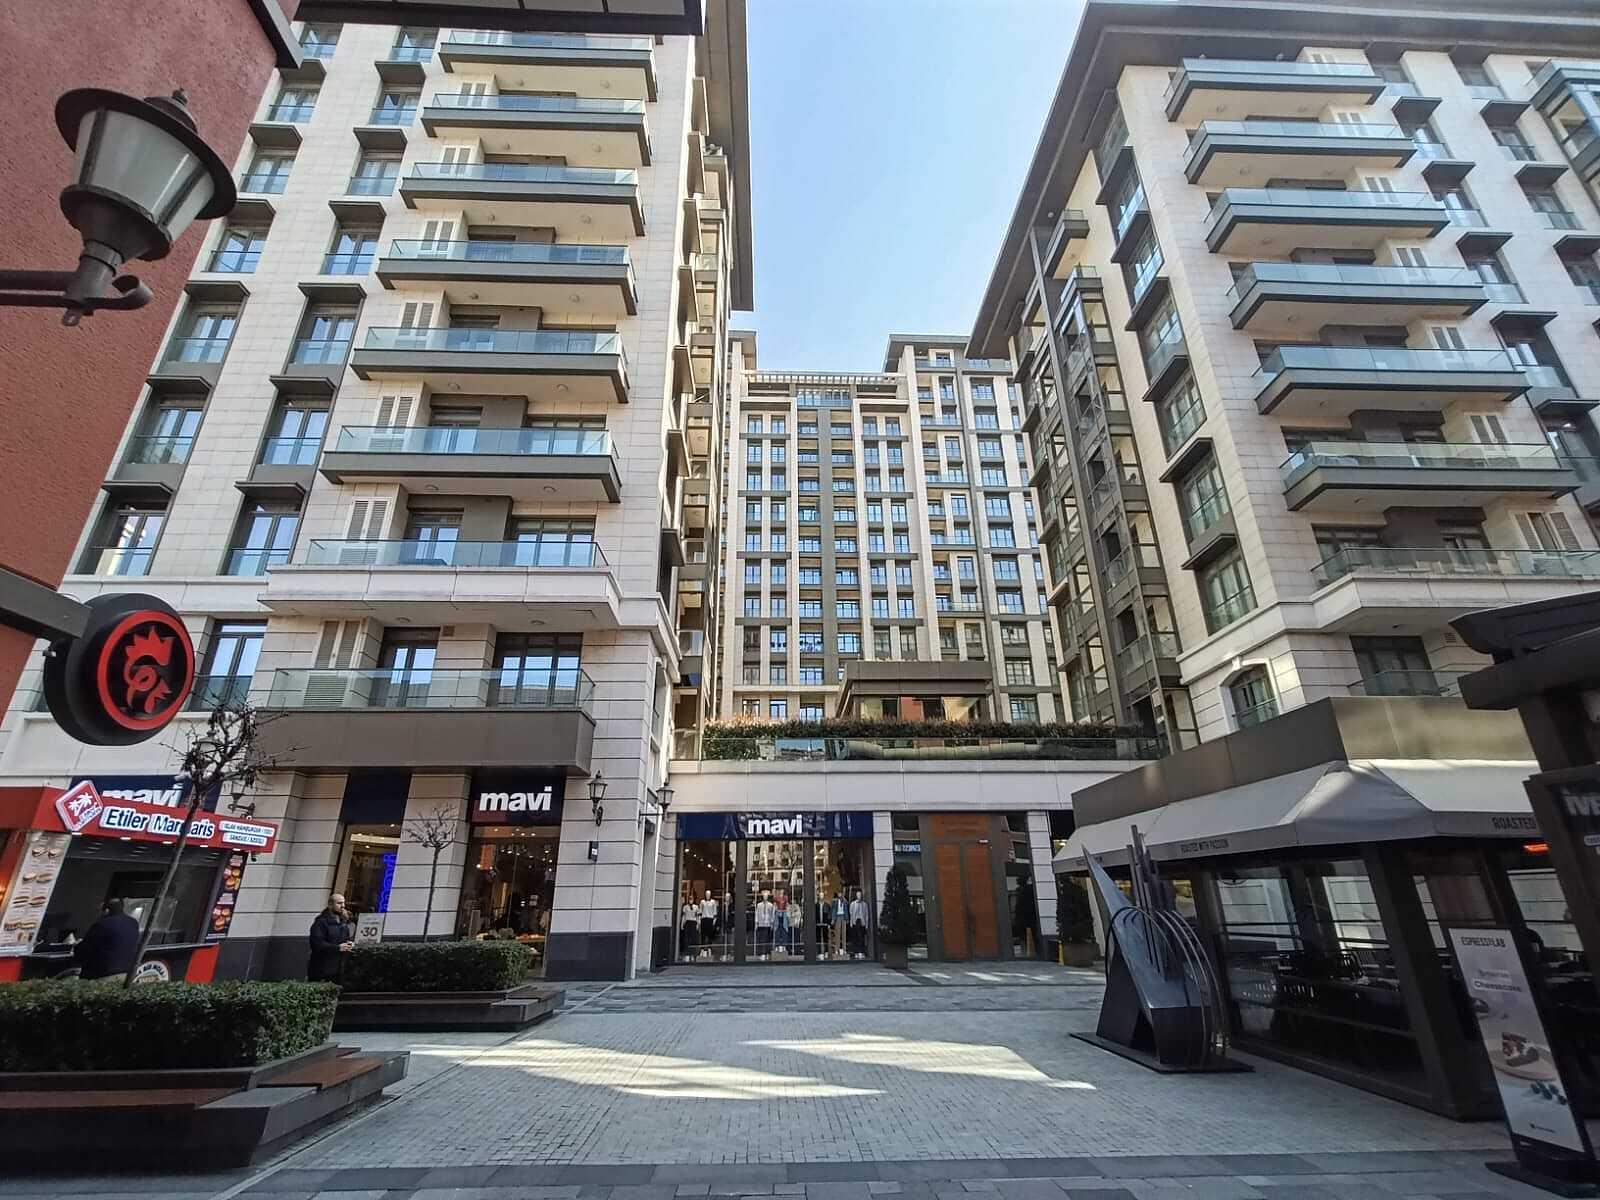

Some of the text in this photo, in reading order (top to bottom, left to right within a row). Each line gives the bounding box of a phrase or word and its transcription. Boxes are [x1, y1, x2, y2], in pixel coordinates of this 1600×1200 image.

[478, 785, 553, 812] mavi
[104, 808, 149, 830] Etiler
[152, 815, 214, 837] Mararis
[747, 813, 803, 835] mavi
